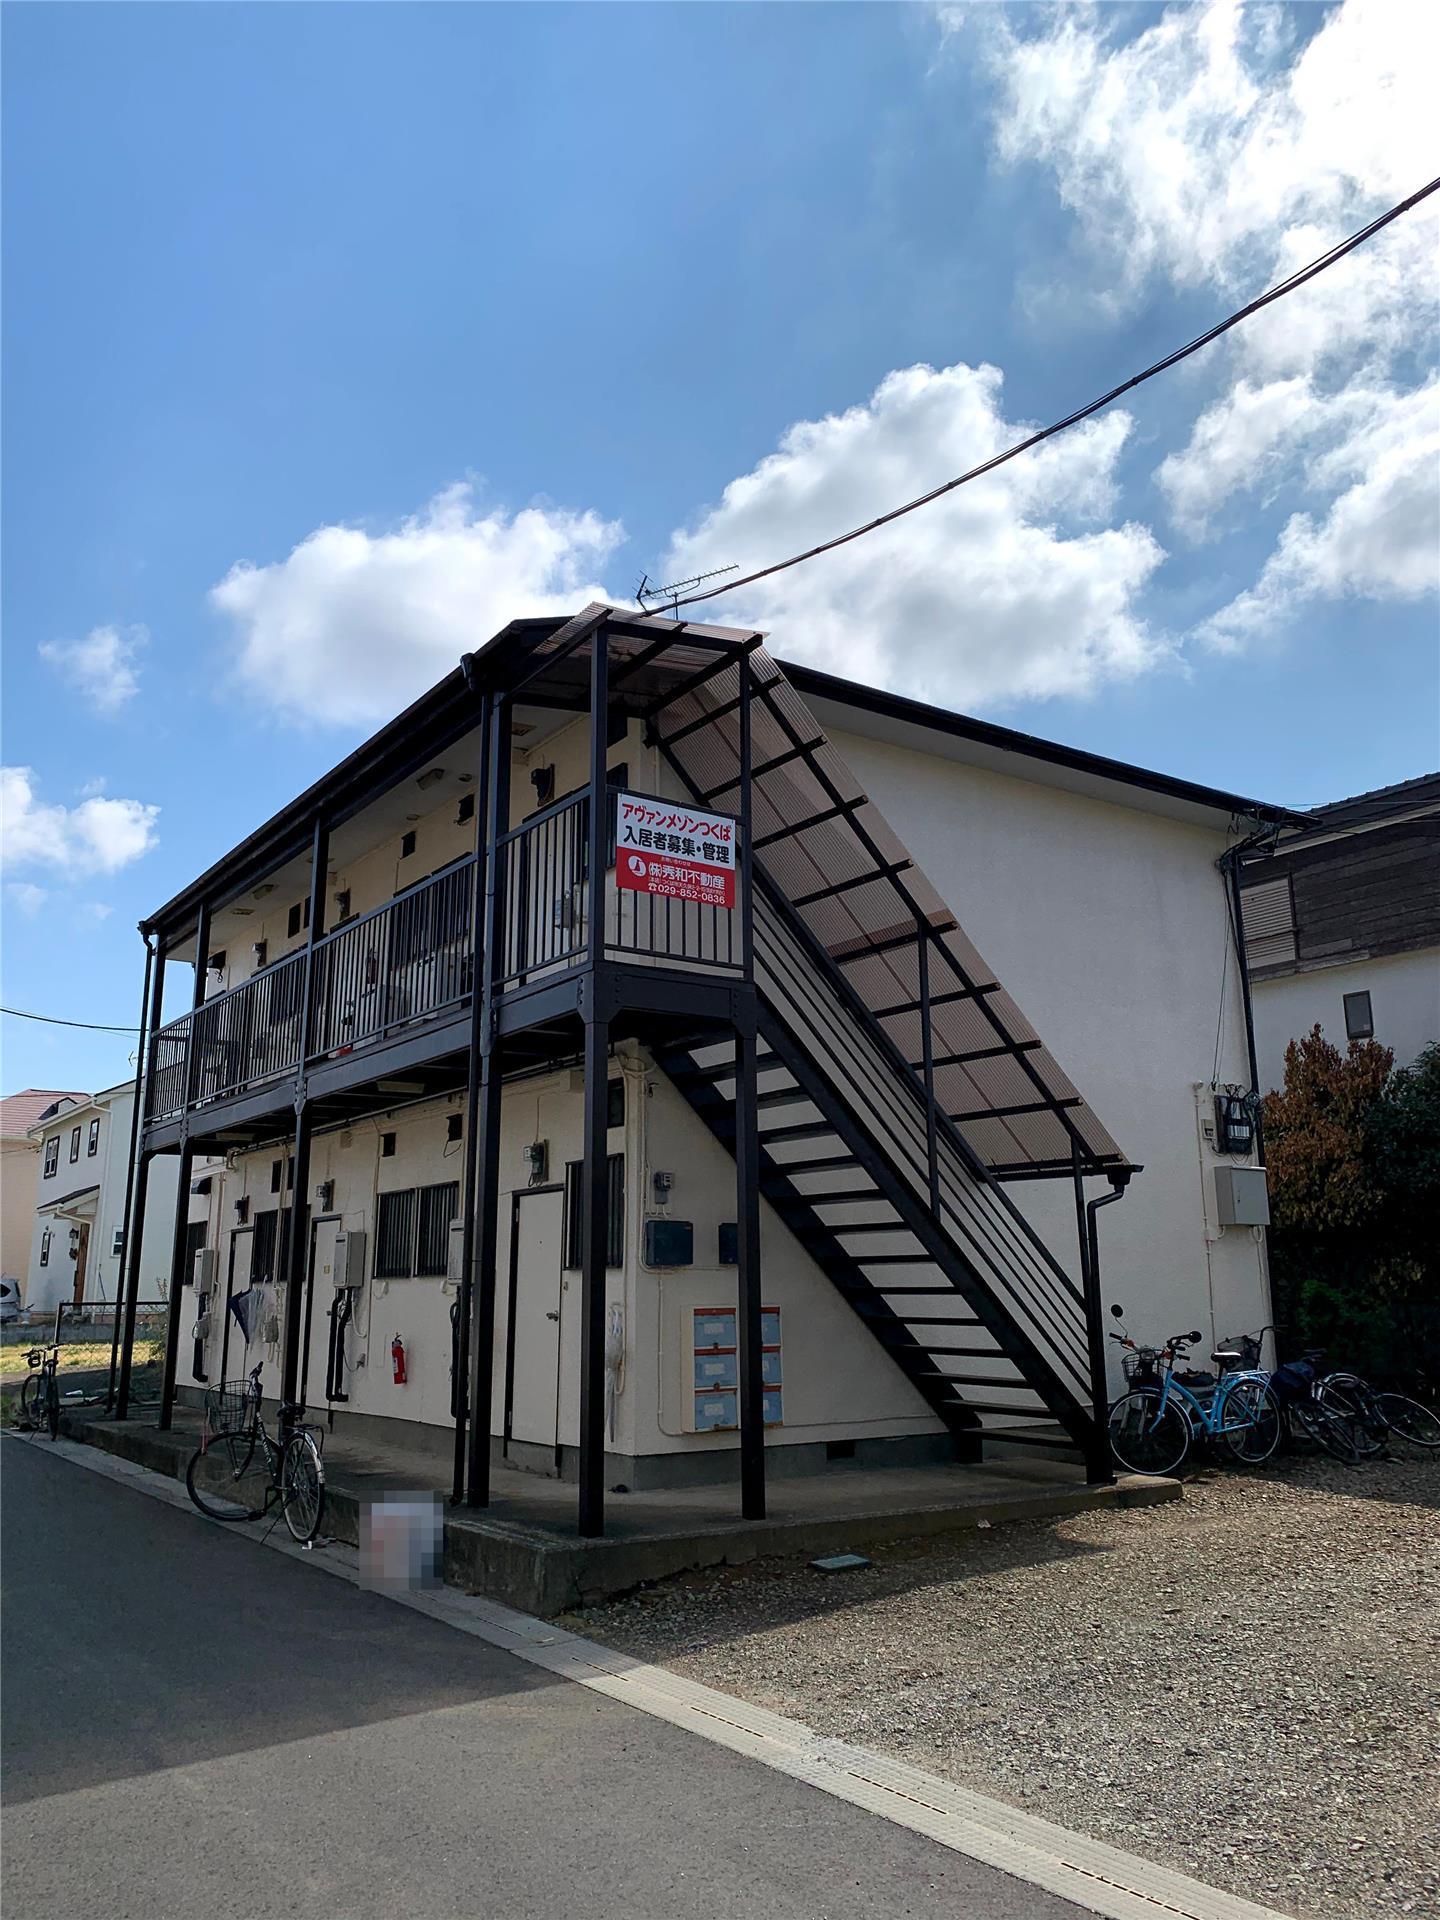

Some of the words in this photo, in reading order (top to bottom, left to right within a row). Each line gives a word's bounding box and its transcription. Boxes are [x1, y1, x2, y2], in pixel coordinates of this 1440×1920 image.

[622, 803, 732, 842] アヴァンメゾンつくば
[623, 825, 730, 864] 入居者募集・管理
[658, 884, 726, 904] 029-852-0836
